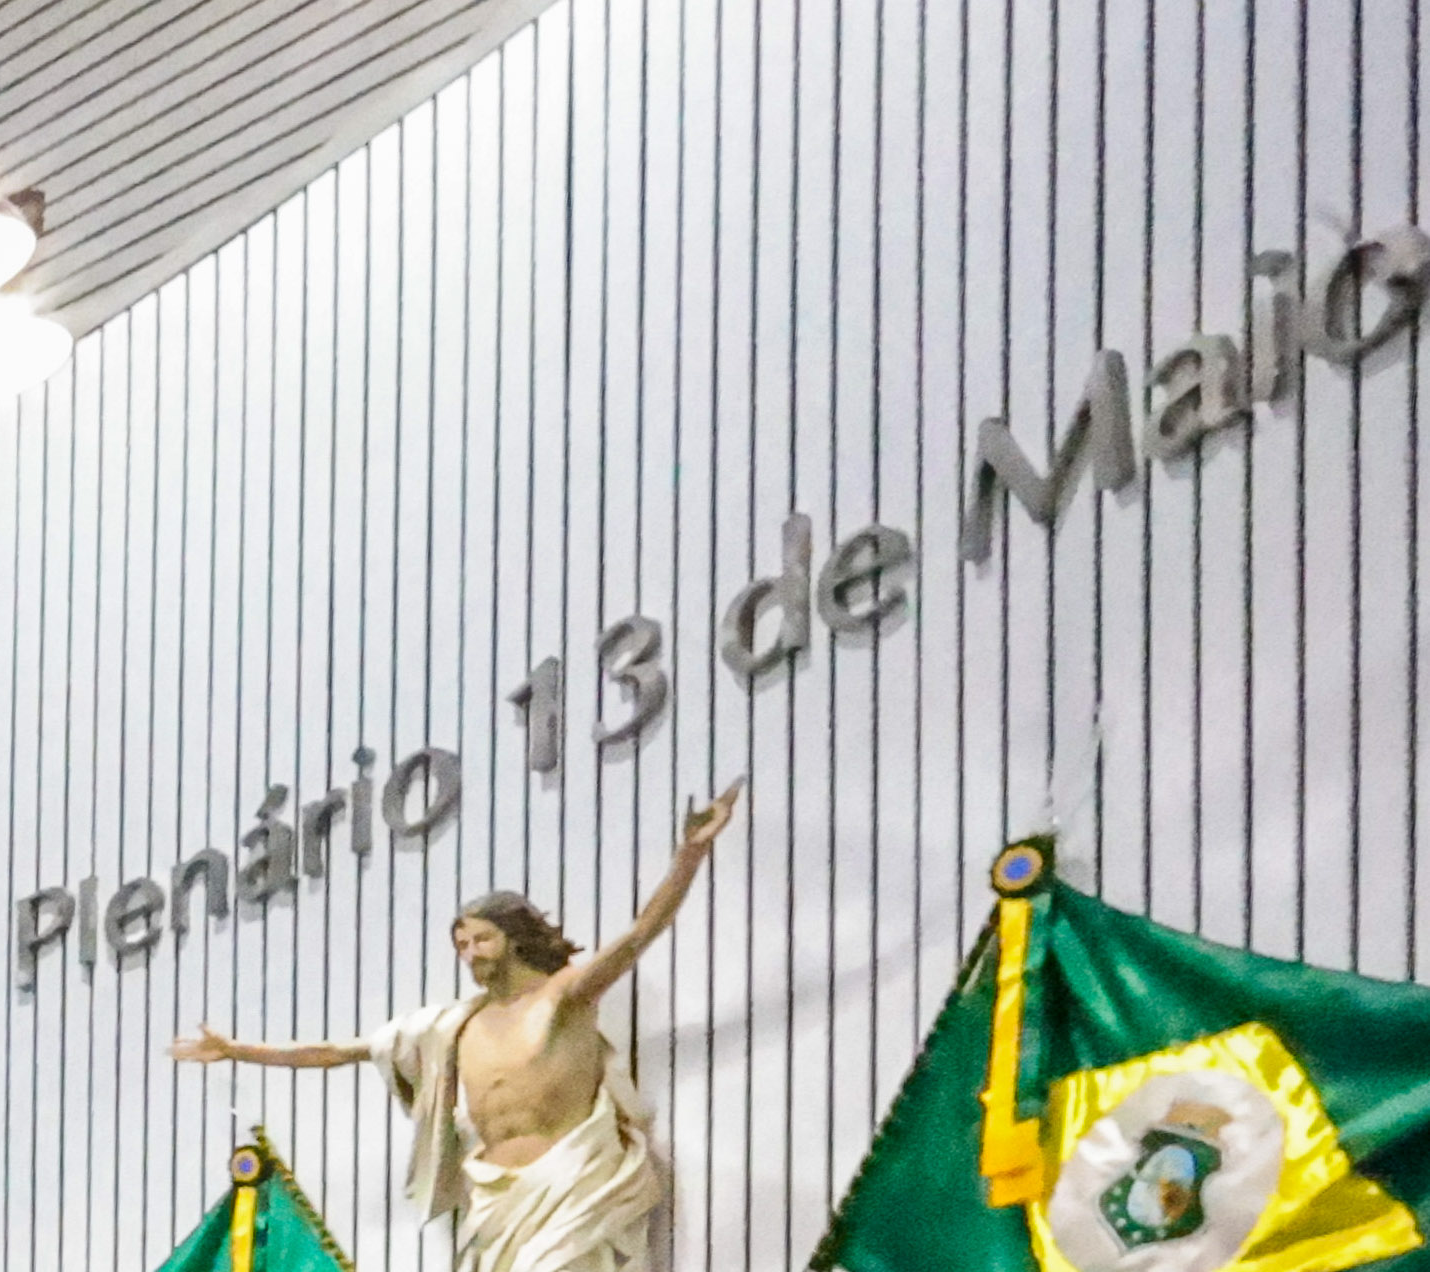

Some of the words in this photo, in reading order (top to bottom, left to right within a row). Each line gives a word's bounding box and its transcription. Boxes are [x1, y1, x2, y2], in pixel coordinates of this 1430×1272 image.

[17, 745, 463, 993] Plenário
[505, 614, 669, 773] 13
[721, 511, 913, 677] de
[958, 224, 1430, 562] Maio
